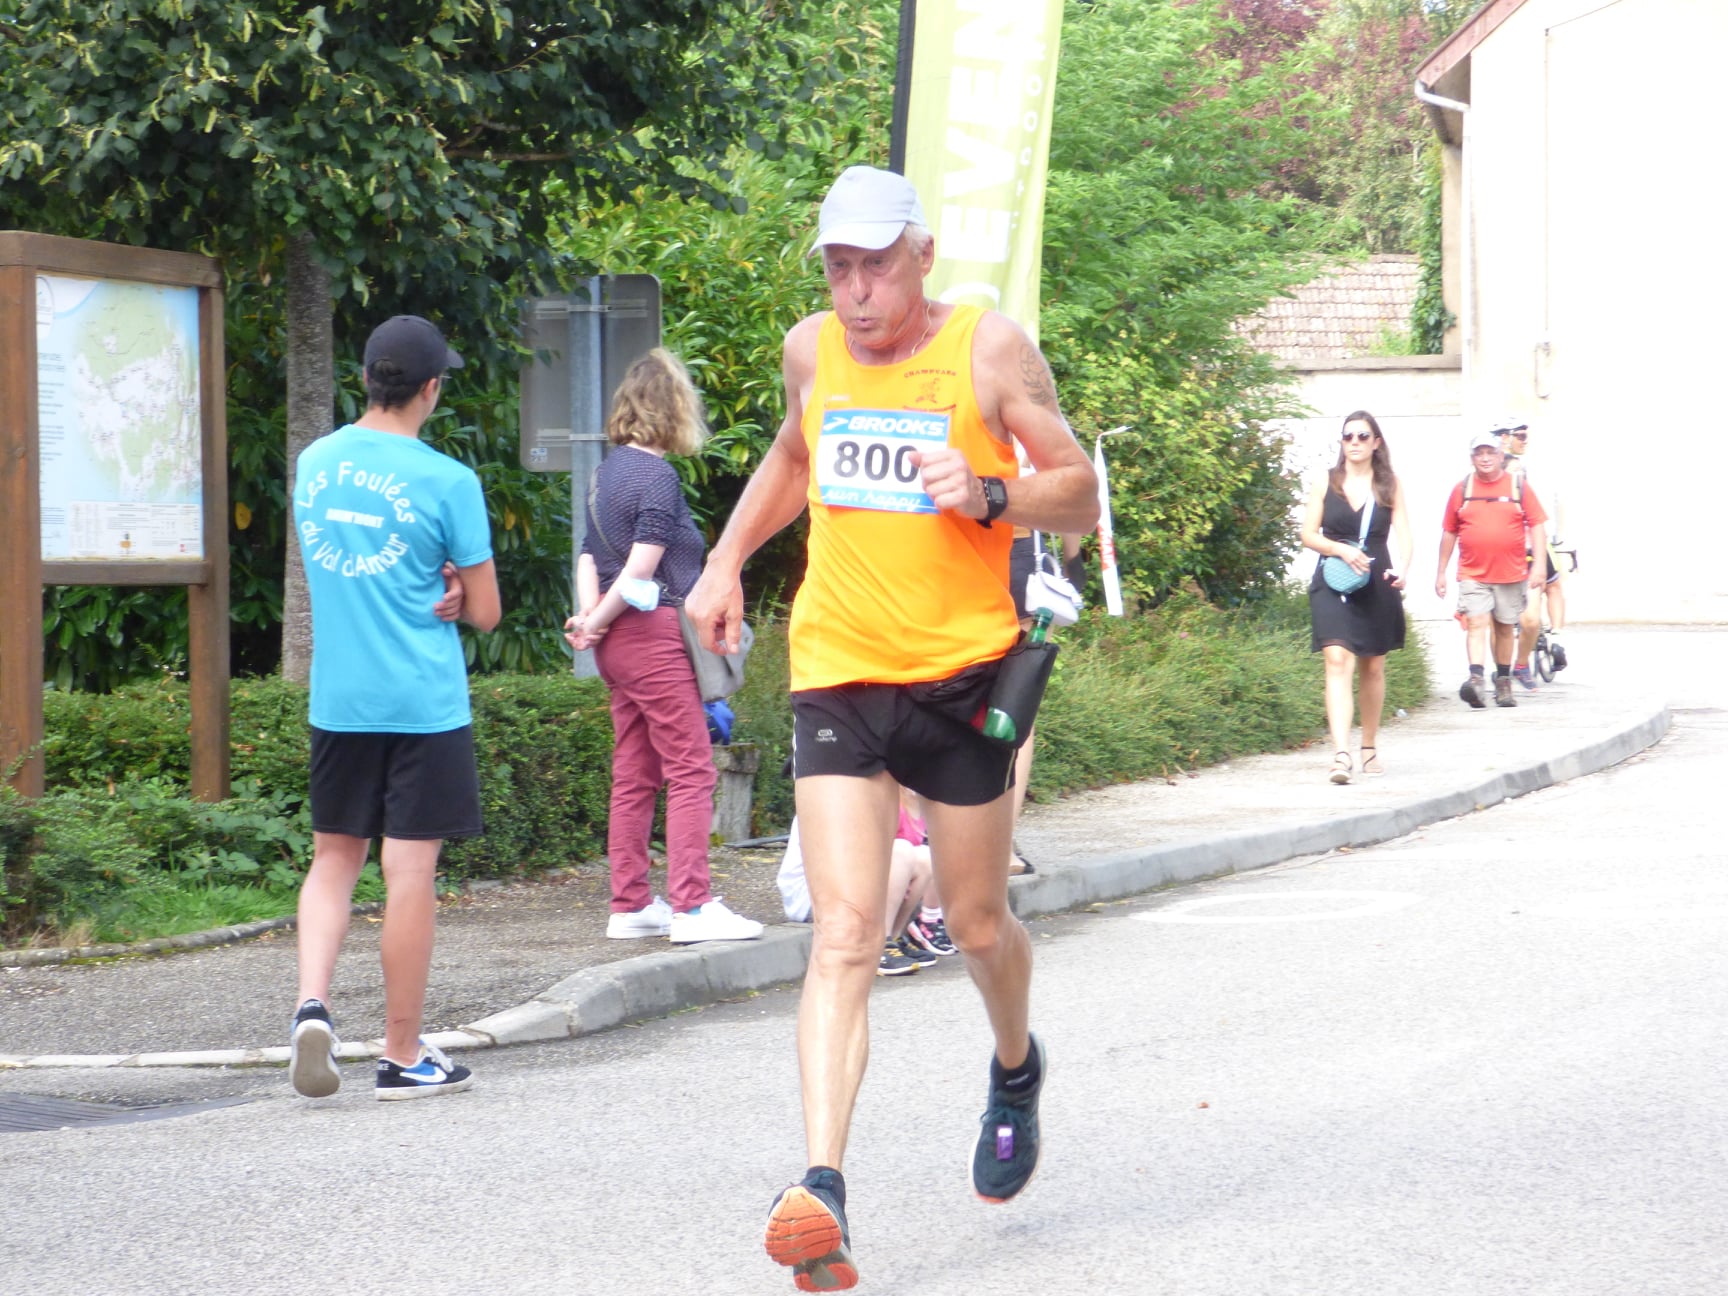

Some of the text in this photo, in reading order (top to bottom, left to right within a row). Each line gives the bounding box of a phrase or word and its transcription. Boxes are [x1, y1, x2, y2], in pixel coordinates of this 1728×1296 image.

[847, 415, 944, 436] BROOKS
[833, 440, 920, 483] 800
[296, 461, 416, 523] Les Foulées
[312, 541, 344, 572] Val
